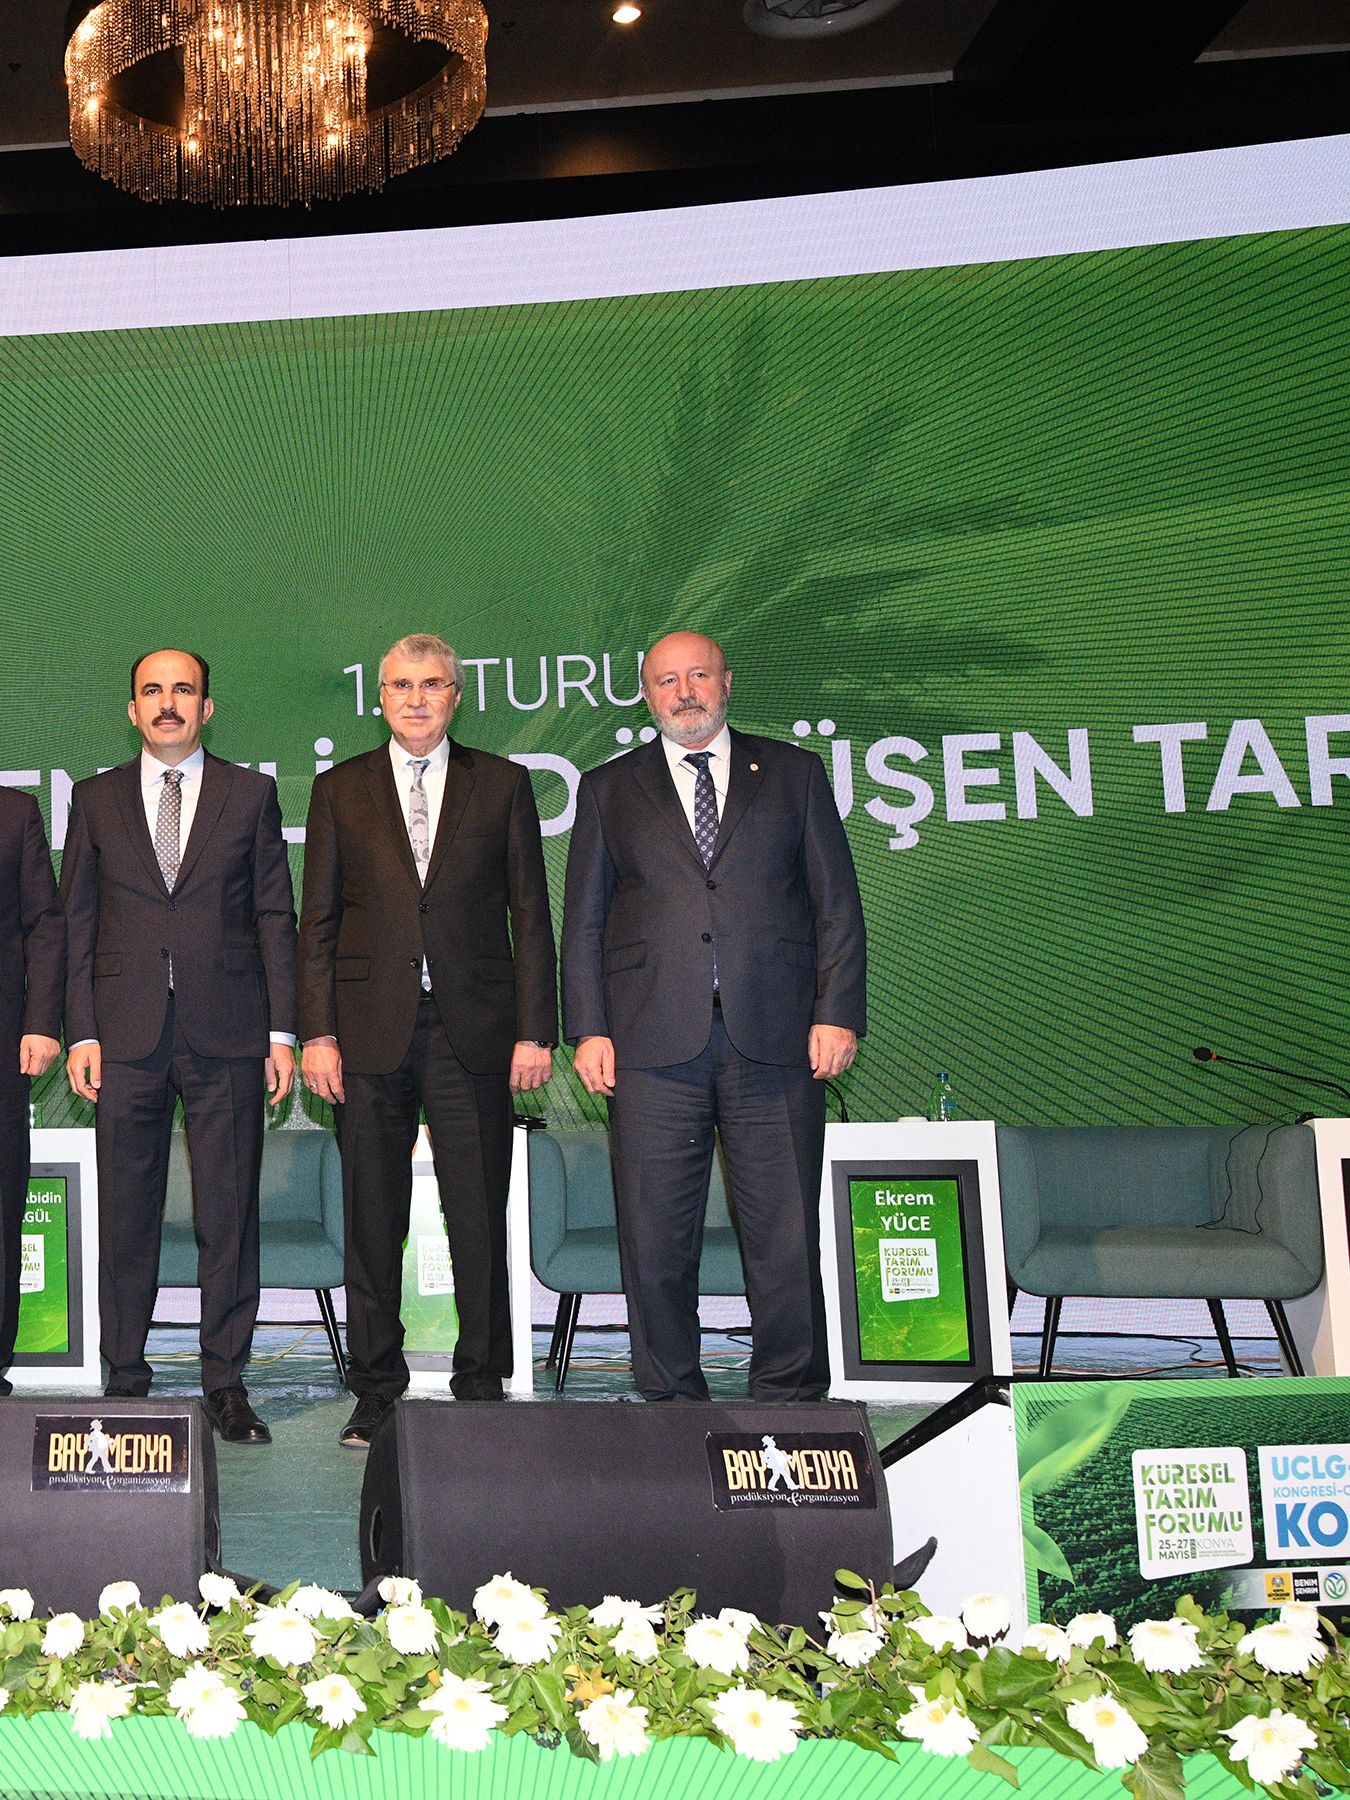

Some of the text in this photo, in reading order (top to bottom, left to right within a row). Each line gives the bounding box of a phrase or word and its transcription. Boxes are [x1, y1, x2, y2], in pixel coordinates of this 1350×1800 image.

[343, 651, 645, 716] 1. TURU
[506, 716, 1094, 851] DÜŞEN
[875, 1190, 934, 1206] Ekrem
[22, 1209, 52, 1223] GÜL
[880, 1213, 931, 1231] YÜCE
[48, 1433, 173, 1473] BAY MEDYA
[722, 1449, 859, 1490] BAY MEDYA
[1141, 1463, 1235, 1486] KÜRESEL
[1271, 1454, 1350, 1481] UCLG
[49, 1474, 102, 1485] prodüksiyon
[113, 1475, 171, 1486] organizasyon
[730, 1491, 787, 1504] prodüksiyon
[799, 1493, 860, 1504] organizasyon
[1143, 1487, 1217, 1510] TARIM
[1159, 1538, 1234, 1550] 25-27 KONYA
[1159, 1550, 1190, 1560] MAYIS
